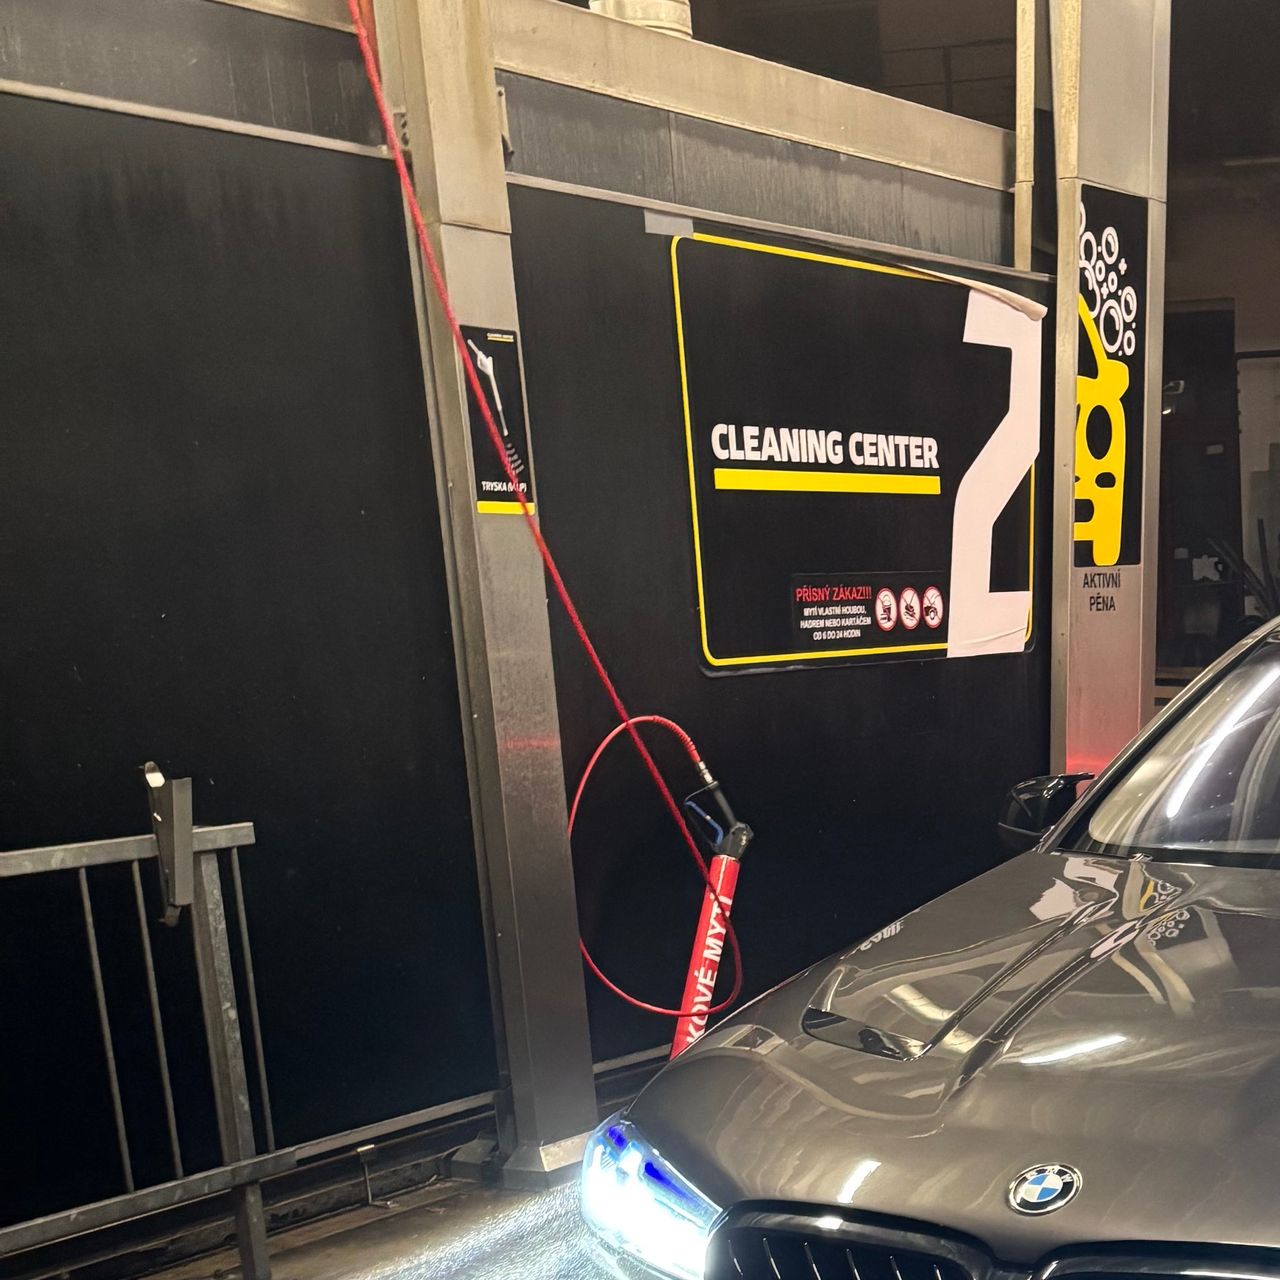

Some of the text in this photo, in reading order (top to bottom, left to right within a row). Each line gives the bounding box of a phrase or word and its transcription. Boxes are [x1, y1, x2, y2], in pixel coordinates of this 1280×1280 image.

[711, 423, 940, 469] CLEANING CENTER
[481, 480, 507, 491] TRYSKA
[1083, 569, 1120, 588] AKTIVNÍ
[796, 584, 872, 602] PŘÍSNÝ ZÁKAZ!!!
[825, 618, 841, 627] NEBO
